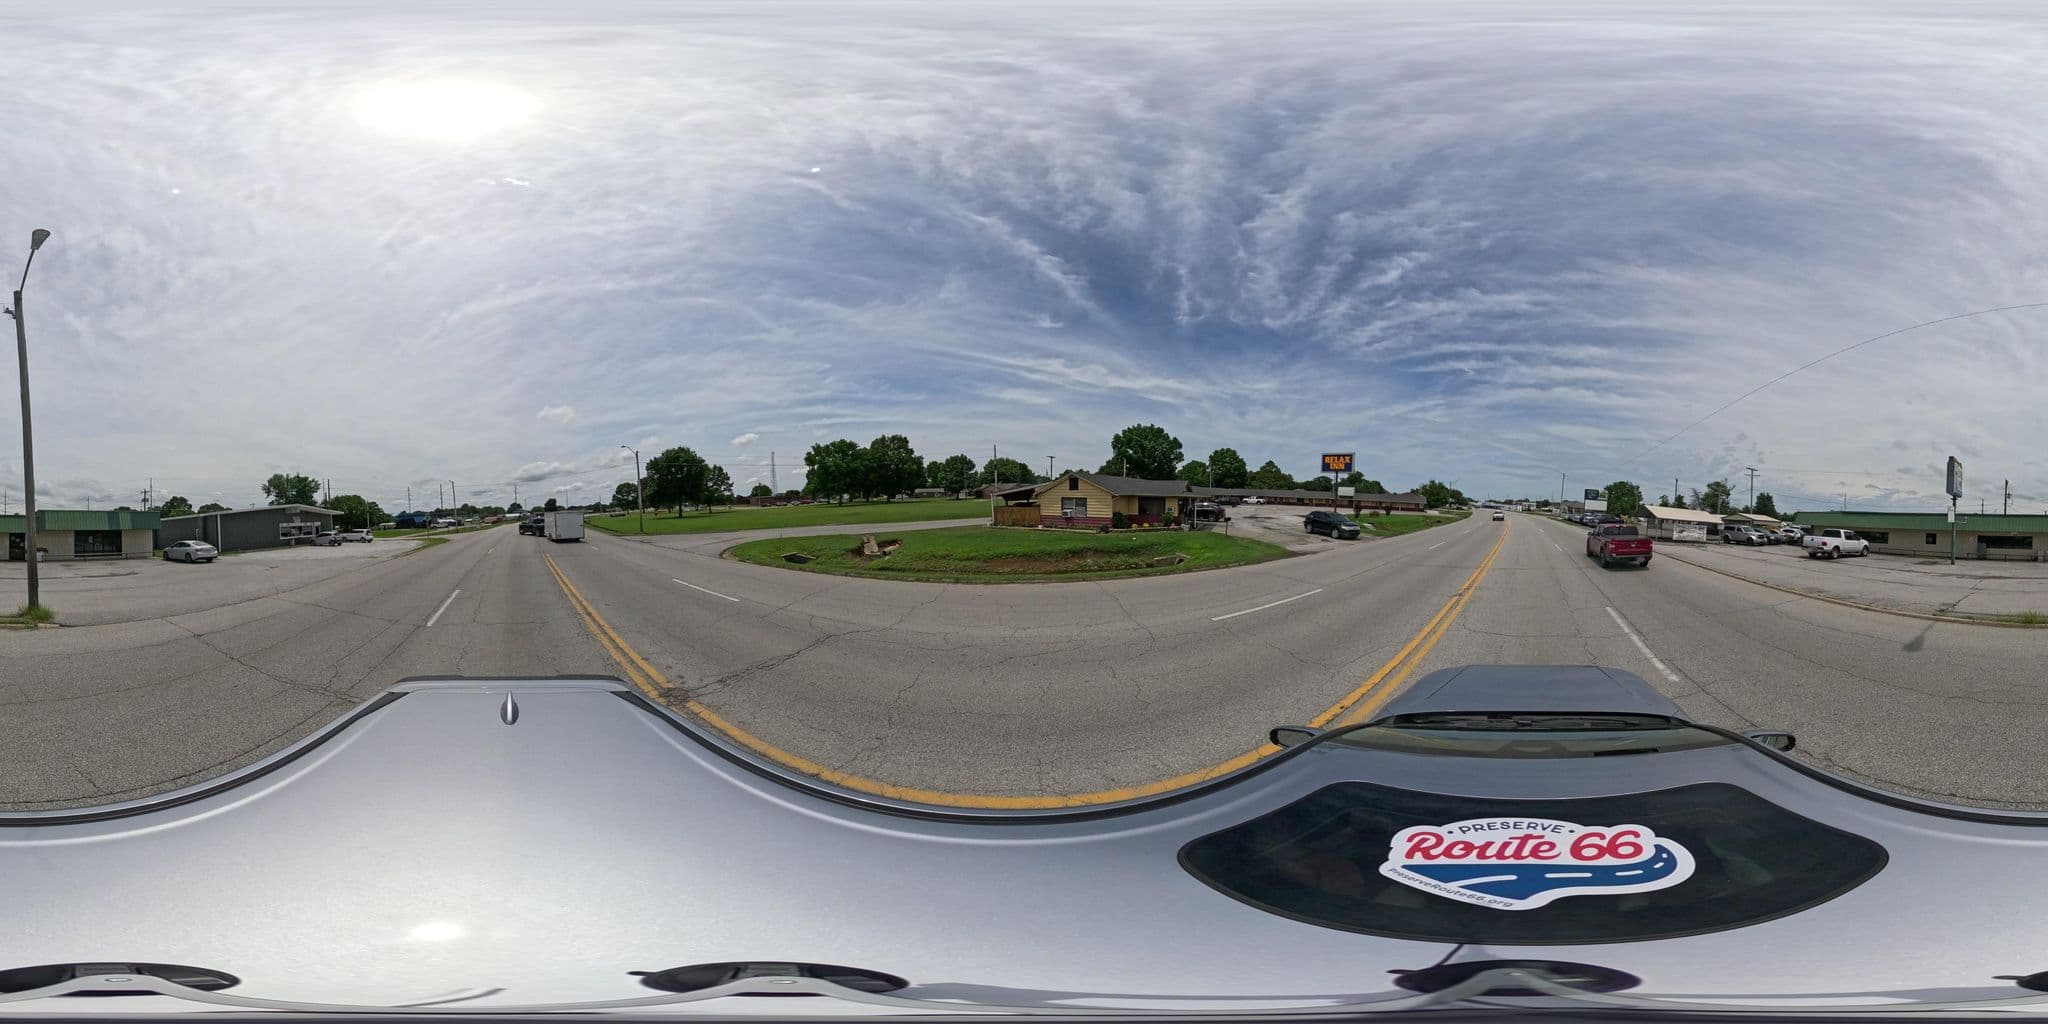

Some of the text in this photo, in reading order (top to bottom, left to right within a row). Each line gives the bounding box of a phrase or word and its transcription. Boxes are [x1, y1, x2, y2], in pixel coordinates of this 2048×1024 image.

[1458, 821, 1565, 834] PRESERVE
[1405, 831, 1643, 861] Route 66
[1388, 867, 1514, 908] PreserveRoute66.org
